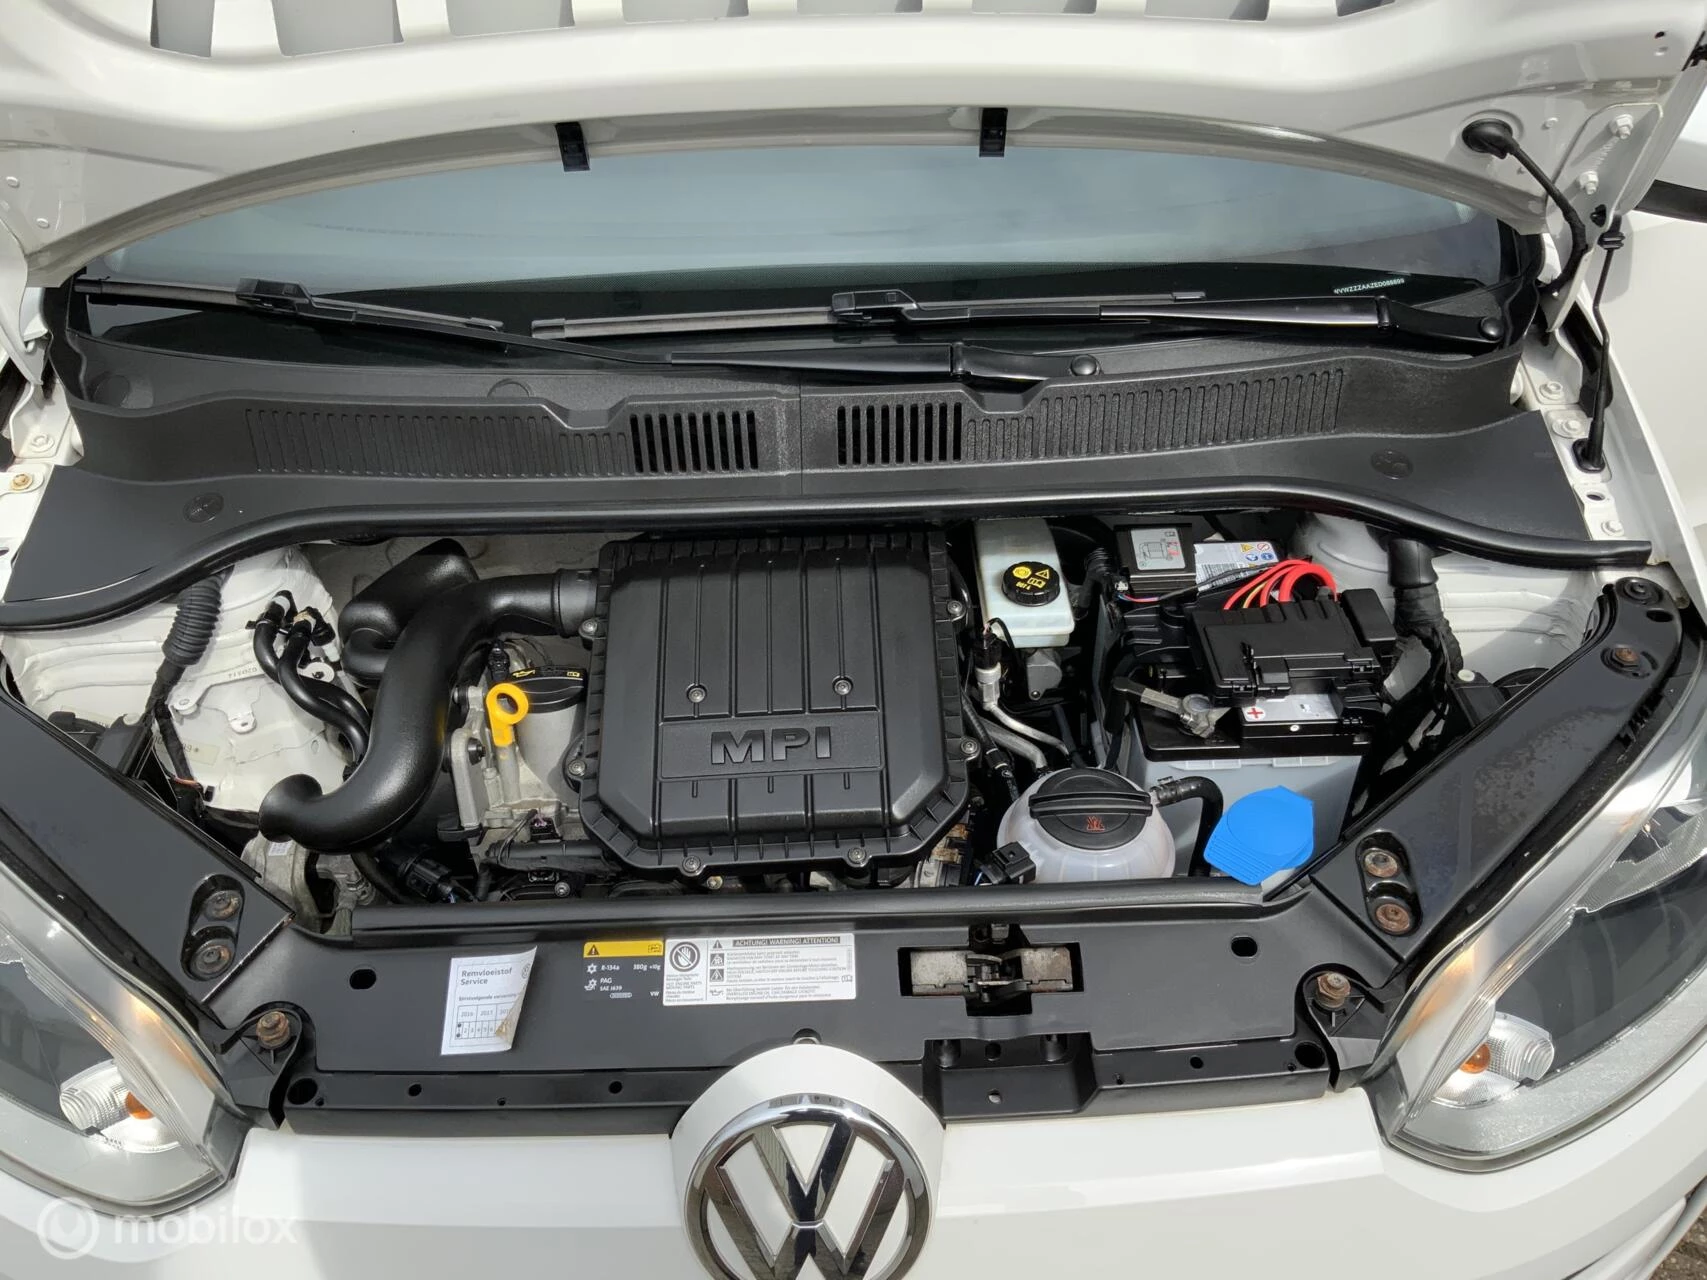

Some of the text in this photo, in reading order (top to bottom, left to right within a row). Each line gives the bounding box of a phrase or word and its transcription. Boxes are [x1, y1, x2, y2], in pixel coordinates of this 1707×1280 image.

[710, 726, 832, 765] MPI
[735, 939, 768, 947] ACHTUNG!
[803, 936, 839, 945] ATTENTION!
[461, 967, 513, 978] Remvloeistof
[460, 978, 488, 986] Service
